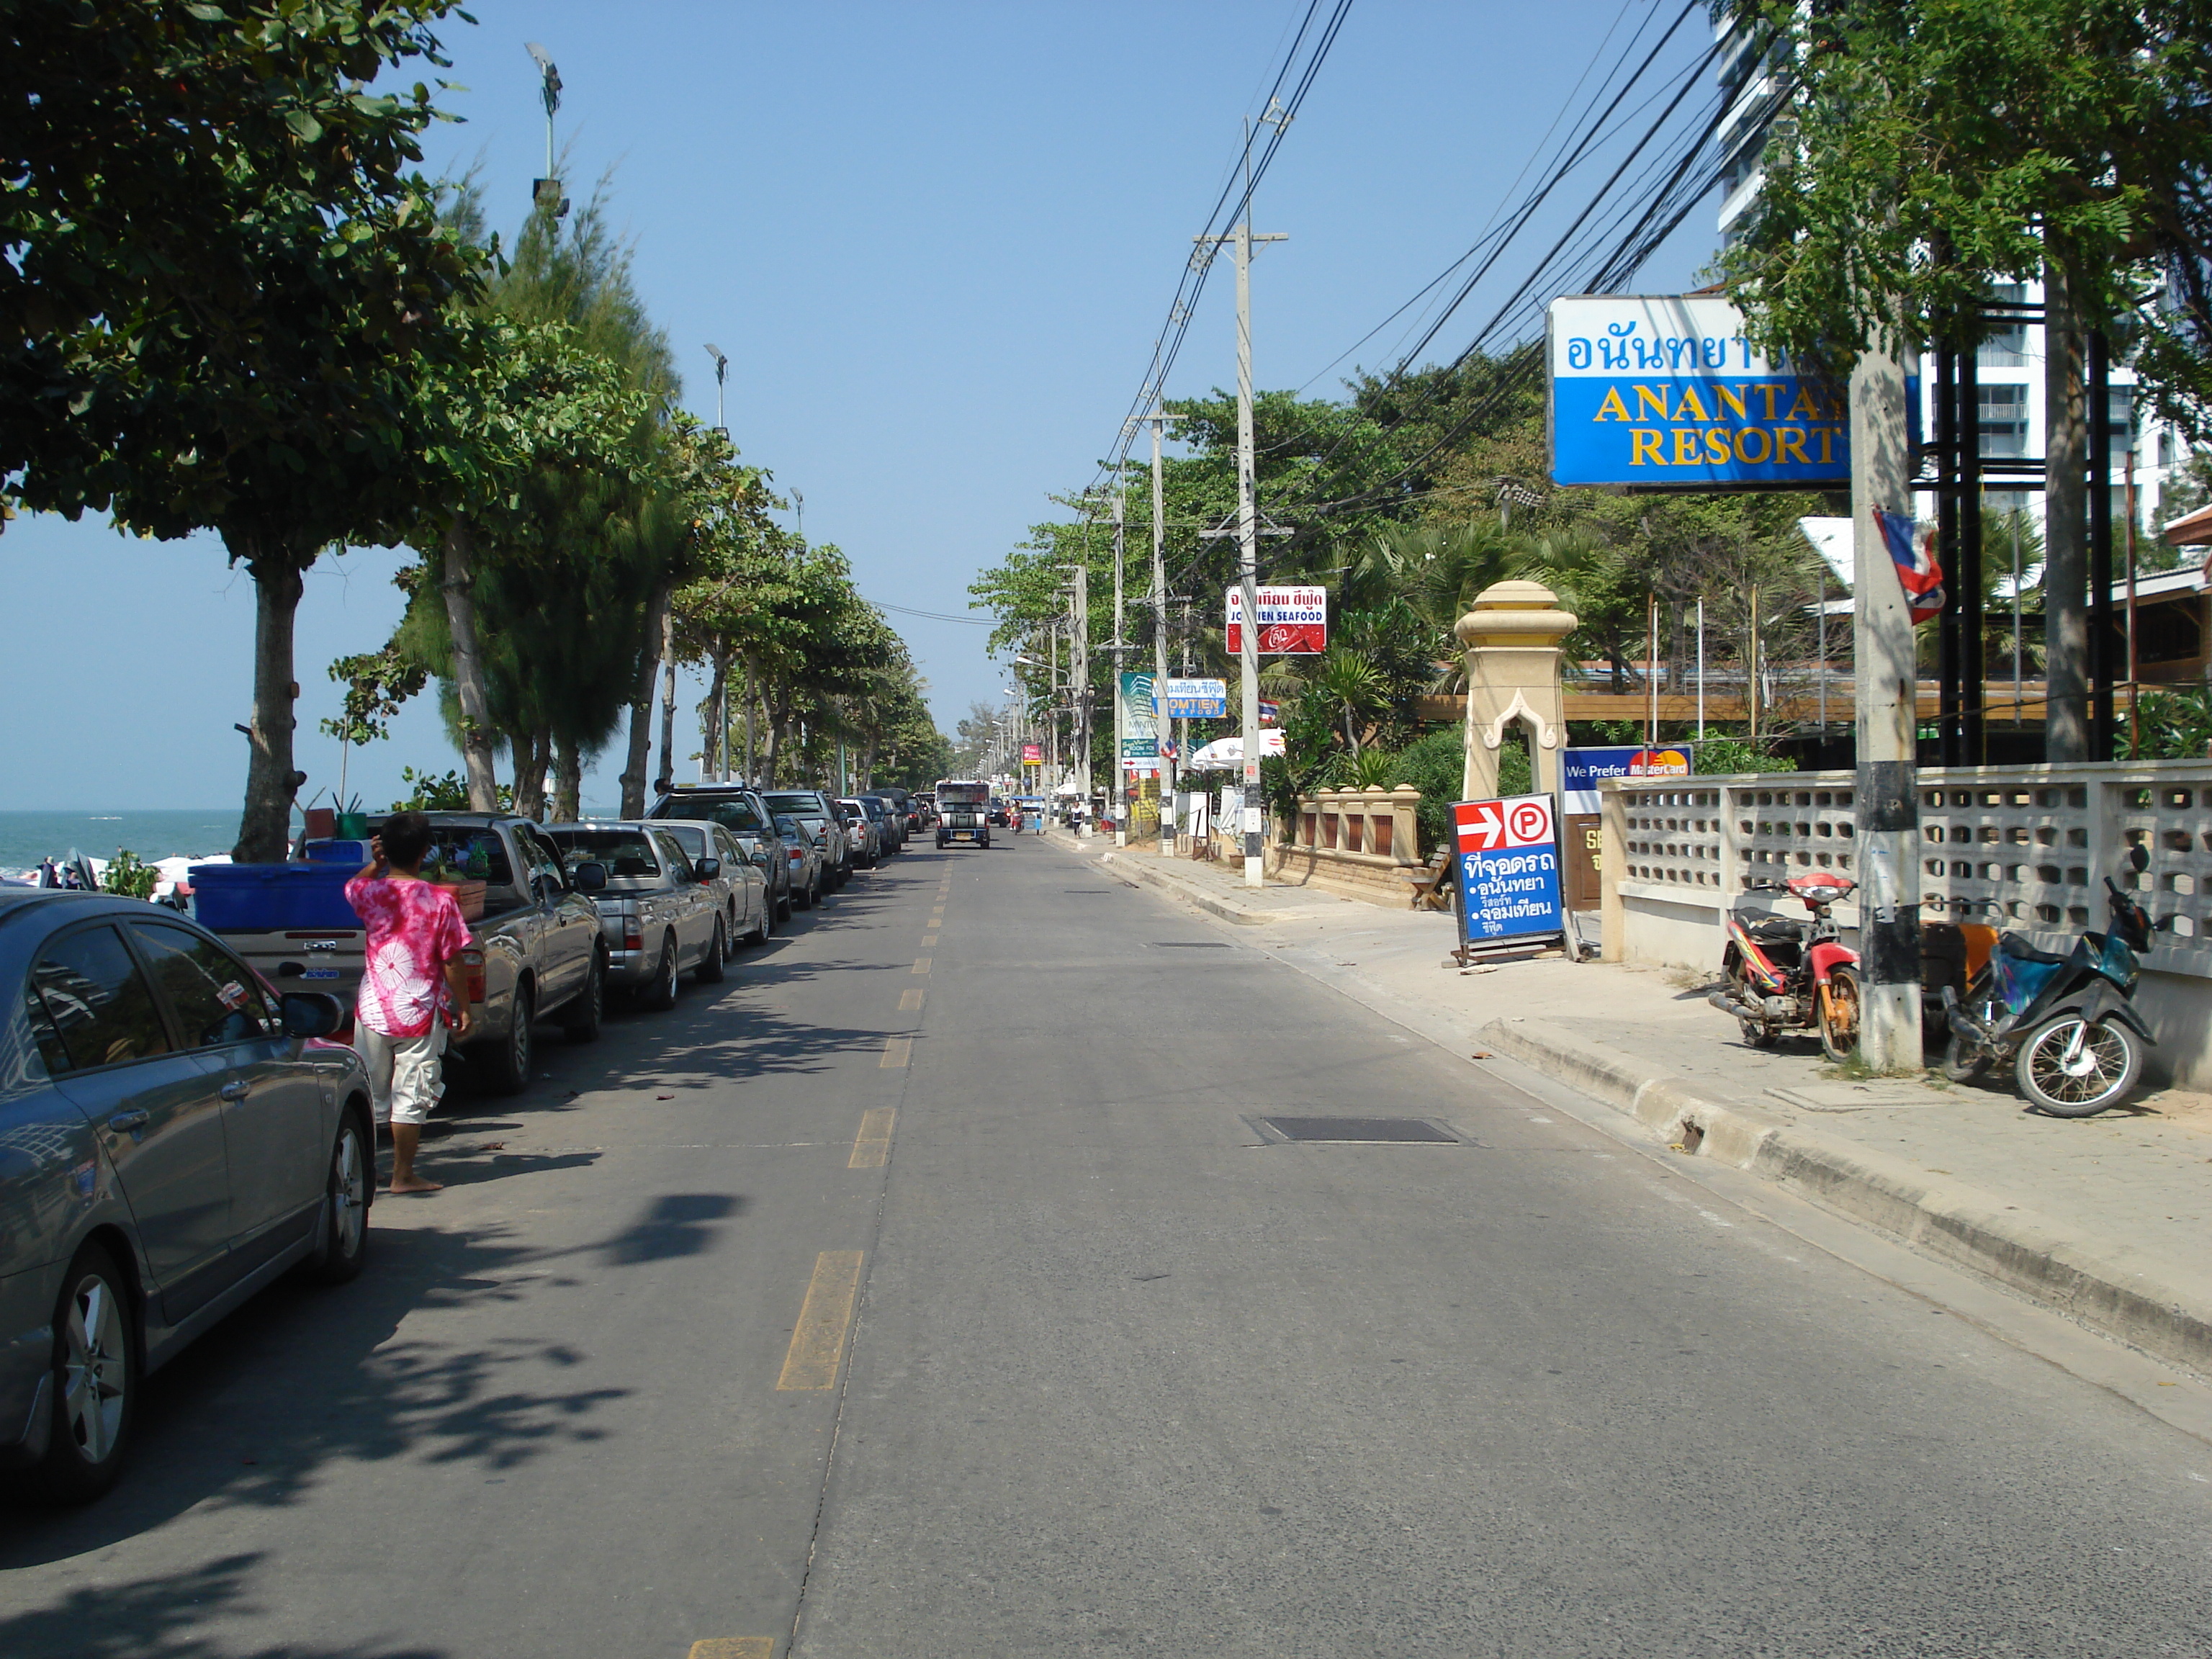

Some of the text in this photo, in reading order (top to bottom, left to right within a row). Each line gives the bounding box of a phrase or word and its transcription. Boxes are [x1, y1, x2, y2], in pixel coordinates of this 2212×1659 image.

[1628, 427, 1842, 466] RESORT
[1231, 611, 1322, 621] JOIEN SEAFOOD
[1169, 698, 1220, 709] OMTIEN
[1566, 766, 1586, 778] We
[1589, 765, 1626, 777] Prefer
[1464, 852, 1555, 878] ที่จอดรถ
[1477, 876, 1545, 896] อนันทยา
